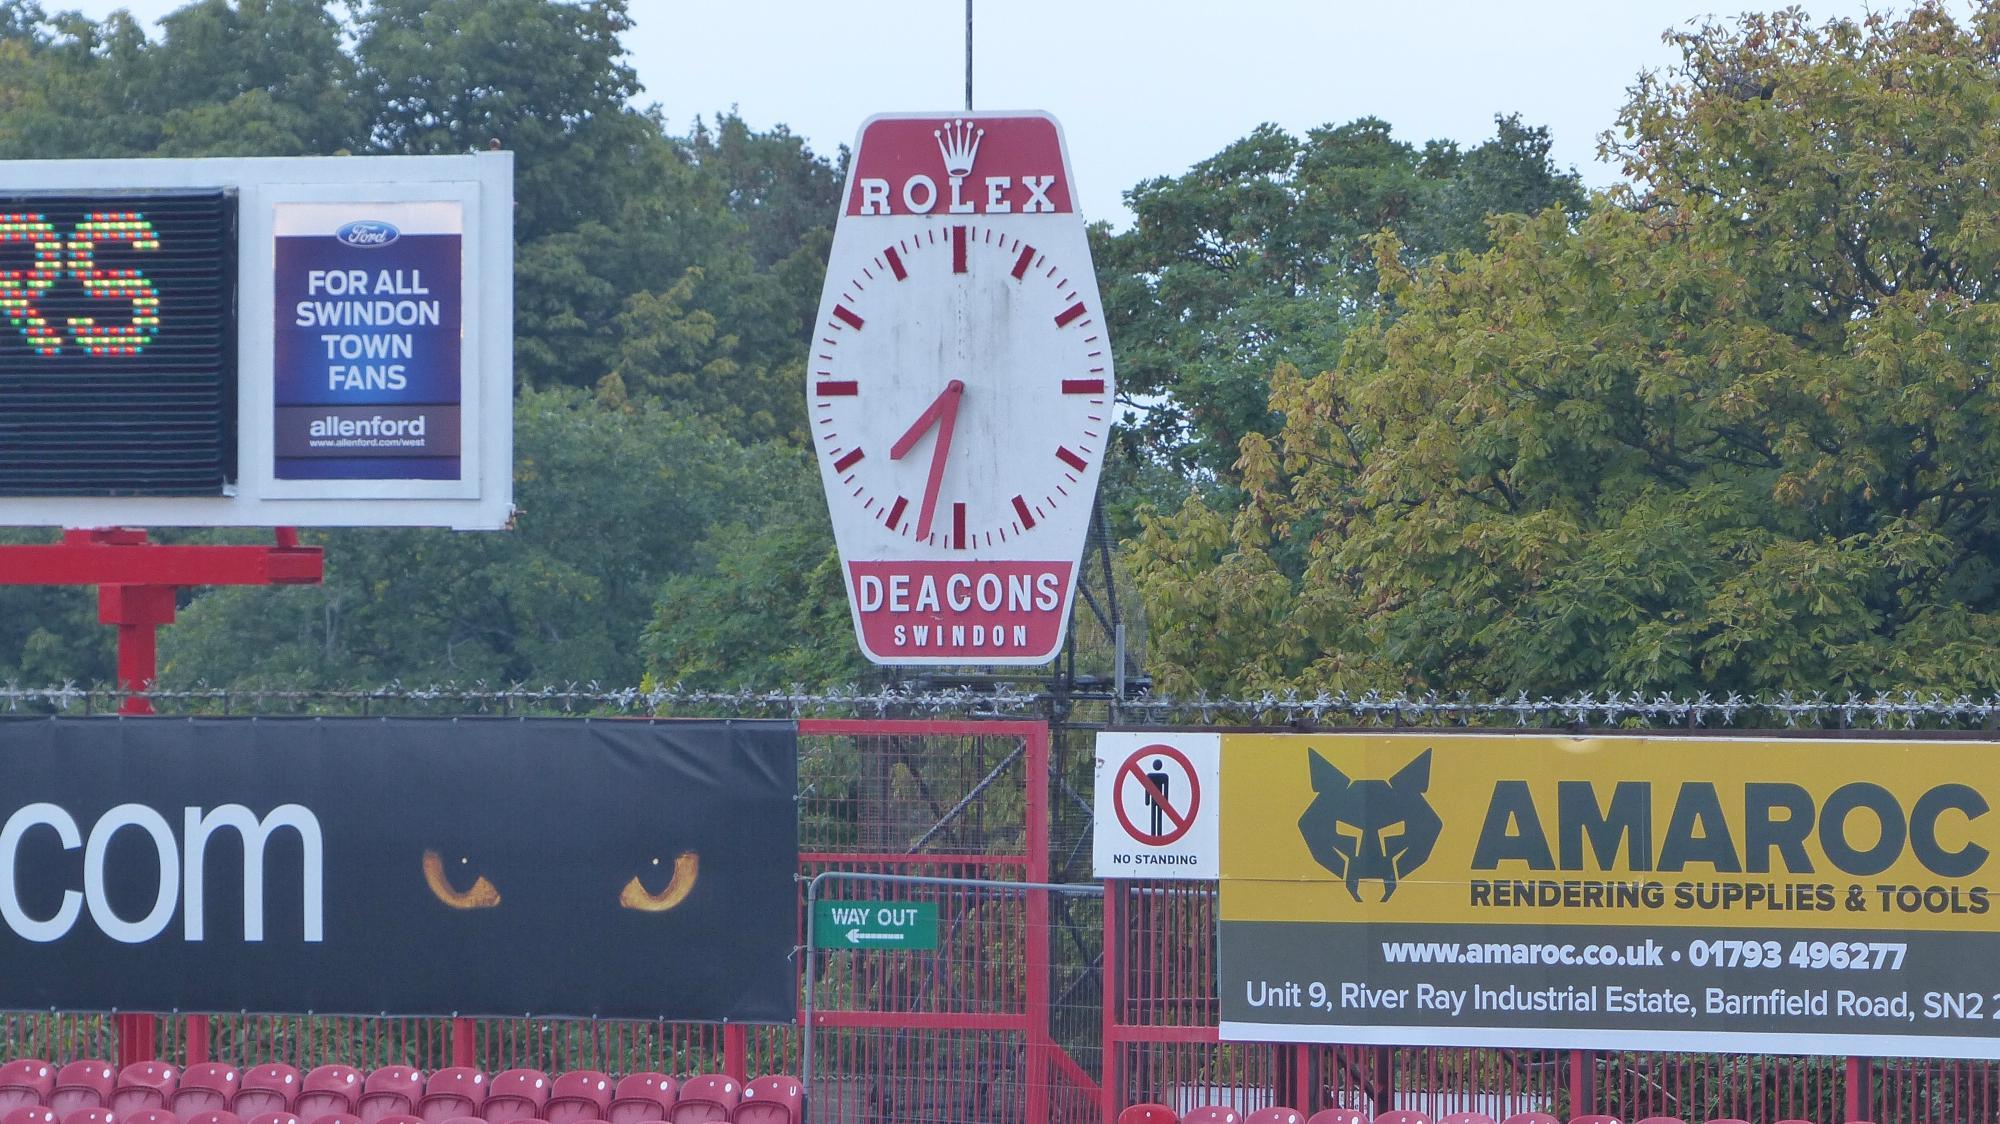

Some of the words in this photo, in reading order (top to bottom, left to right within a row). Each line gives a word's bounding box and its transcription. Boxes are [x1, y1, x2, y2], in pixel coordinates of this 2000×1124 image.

[860, 174, 1055, 215] ROLEX
[348, 223, 388, 244] Ford
[308, 270, 367, 295] FOR
[374, 269, 429, 295] ALL
[295, 300, 440, 327] SWINDON
[321, 334, 413, 359] TOWN
[328, 364, 407, 391] FANS
[309, 415, 425, 436] allenford
[309, 438, 425, 448] www.allenford.com/west
[860, 573, 1060, 612] DEACONS
[894, 624, 1026, 647] SWINDON
[1470, 780, 1991, 878] AMAROC
[1113, 854, 1131, 864] NO
[1135, 854, 1197, 865] STANDING
[1470, 879, 1665, 909] RENDERING
[1674, 882, 1836, 912] SUPPLIES
[1845, 884, 1867, 912] &
[1876, 885, 1990, 915] TOOLS
[831, 907, 870, 926] WAY
[877, 908, 918, 926] OUT
[1382, 939, 1664, 967] www.amaroc.co.uk
[1688, 939, 1782, 969] 01793
[1788, 941, 1907, 970] 496277
[1246, 981, 1301, 1008] Unit
[1308, 981, 1333, 1012] 9,
[1341, 981, 1408, 1010] River
[1416, 983, 1467, 1016] Ray
[1474, 984, 1597, 1012] Industrial
[1606, 985, 1697, 1018] Estate,
[1706, 987, 1828, 1017] Barnfield
[1837, 989, 1915, 1021] Road,
[1923, 991, 1984, 1019] SN2
